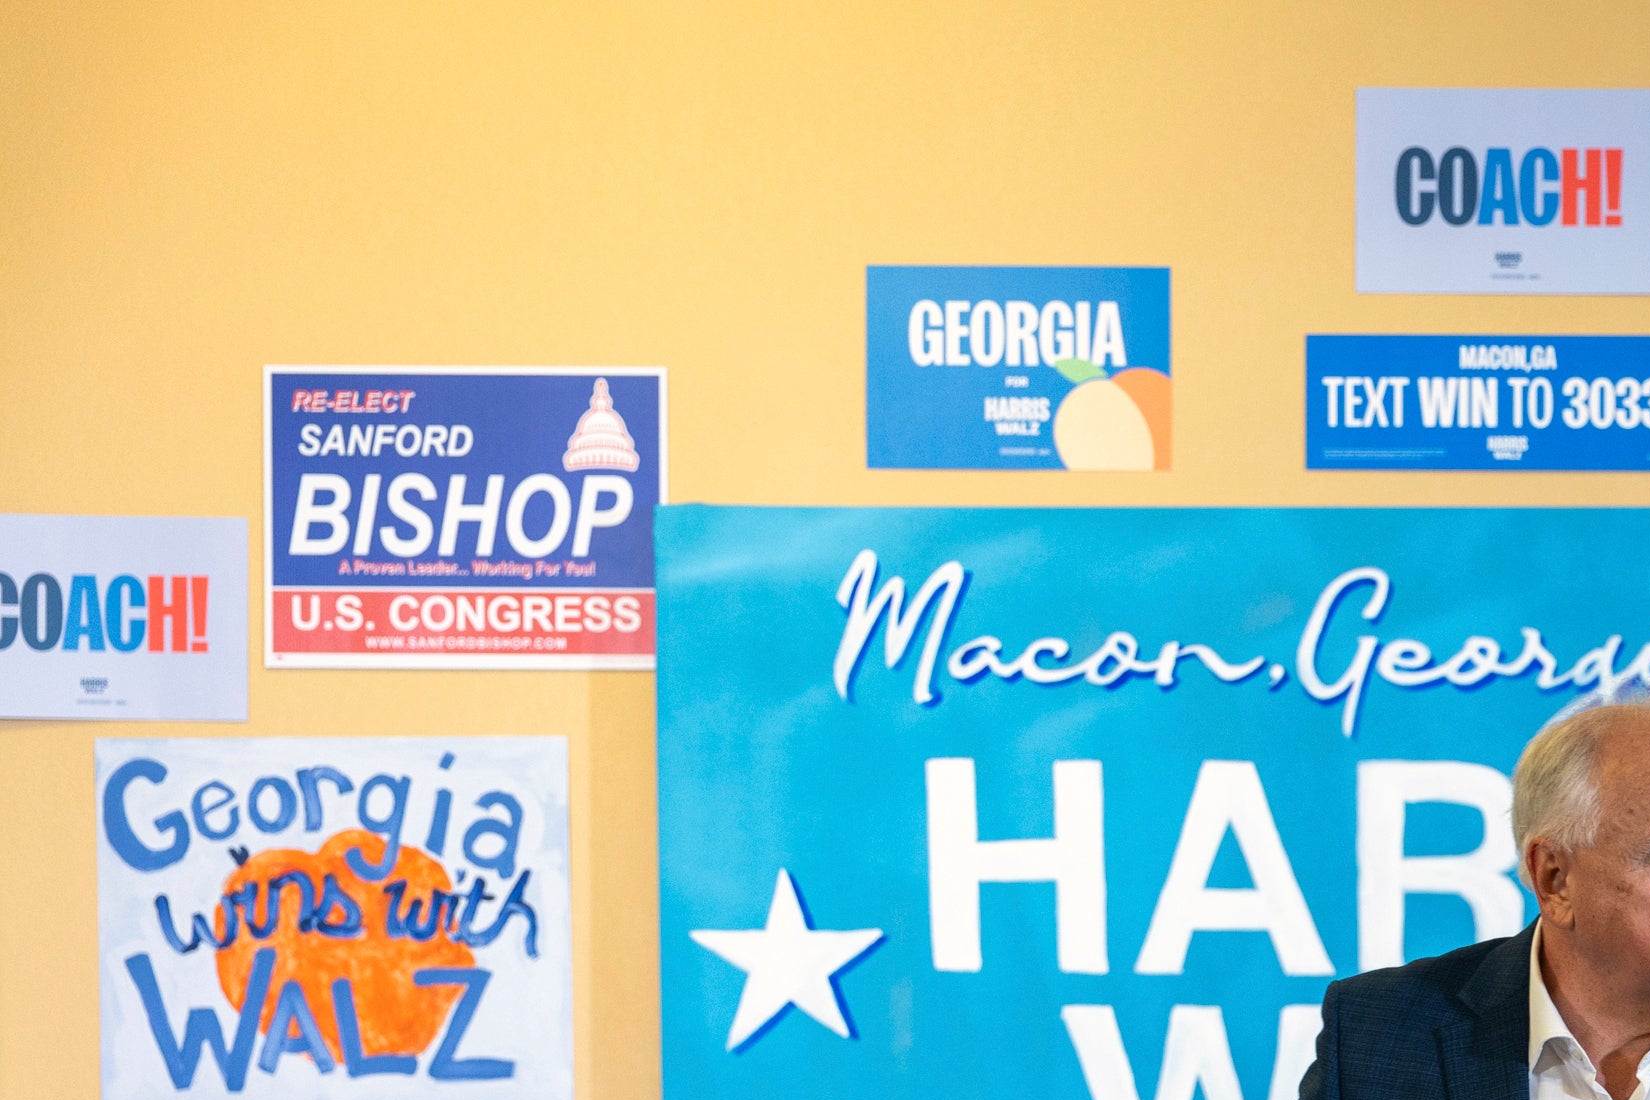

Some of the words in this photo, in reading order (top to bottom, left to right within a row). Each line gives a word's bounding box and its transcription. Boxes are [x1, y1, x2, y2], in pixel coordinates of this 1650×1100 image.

[1395, 145, 1624, 227] COACH!
[908, 300, 1127, 368] GEORGIA
[1004, 376, 1029, 388] FOR
[292, 390, 415, 414] RE-ELECT
[984, 397, 1050, 421] HARRIS
[1322, 376, 1410, 429] TEXT
[1417, 376, 1499, 429] WIN
[1507, 376, 1554, 429] TO
[298, 424, 474, 457] SANFORD
[995, 422, 1041, 436] WALZ
[289, 473, 634, 558] BISHOP
[535, 561, 560, 576] For
[291, 595, 376, 632] U.S.
[389, 595, 642, 632] CONGRESS
[102, 752, 525, 882] Georgia
[124, 947, 516, 1093] WALZ
